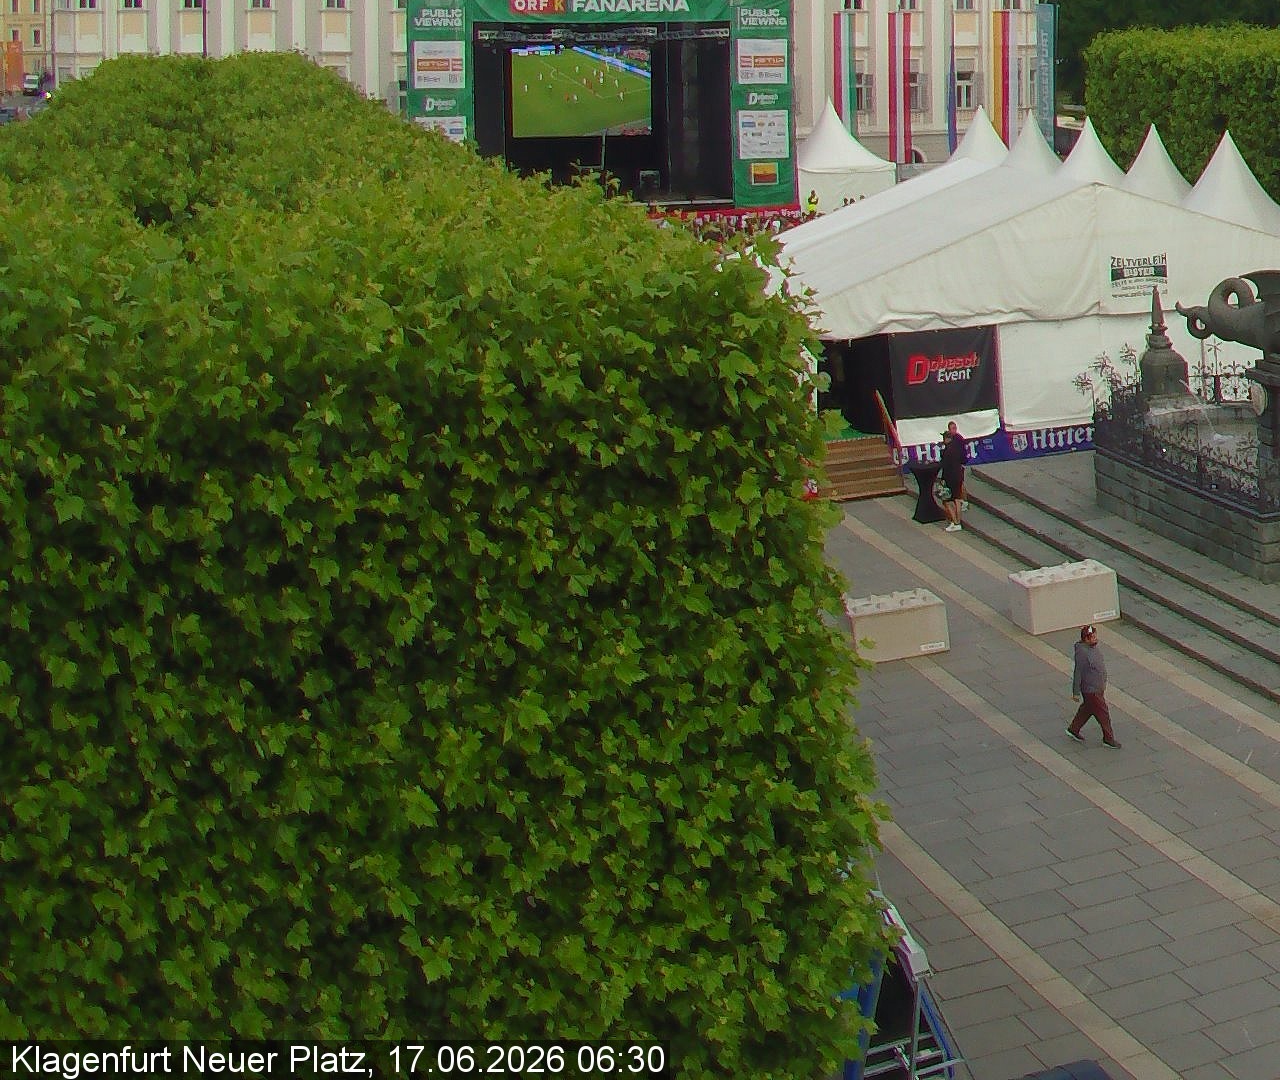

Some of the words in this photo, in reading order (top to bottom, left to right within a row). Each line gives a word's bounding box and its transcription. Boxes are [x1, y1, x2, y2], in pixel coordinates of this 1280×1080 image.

[421, 8, 463, 18] PUBLIC
[741, 8, 780, 17] PUBLIC
[414, 17, 463, 27] VIEWING
[741, 17, 788, 26] VIEWING
[1111, 253, 1167, 269] ZELTVERLEIH
[937, 368, 972, 383] Event
[1032, 426, 1095, 450] Hirter
